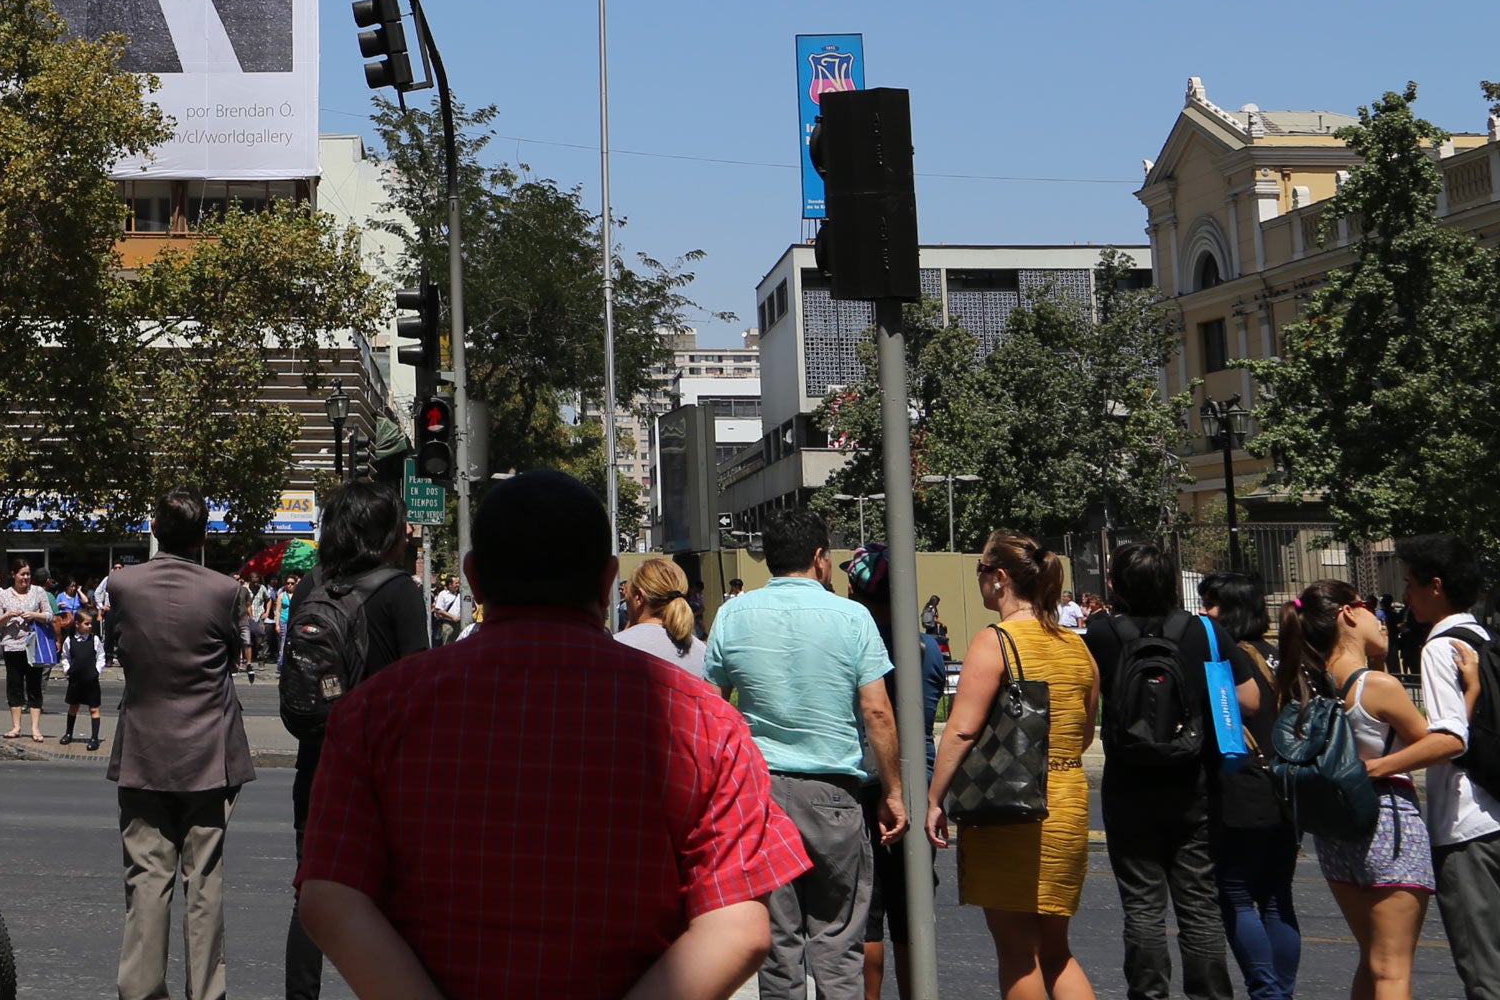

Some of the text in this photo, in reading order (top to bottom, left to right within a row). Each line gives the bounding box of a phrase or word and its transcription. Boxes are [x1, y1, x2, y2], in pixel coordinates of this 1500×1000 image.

[186, 106, 210, 121] por
[216, 103, 274, 118] Brendan
[164, 129, 293, 147] m/cl/worldgallery
[410, 487, 438, 495] EN DOS
[411, 499, 438, 507] TIEMPOS
